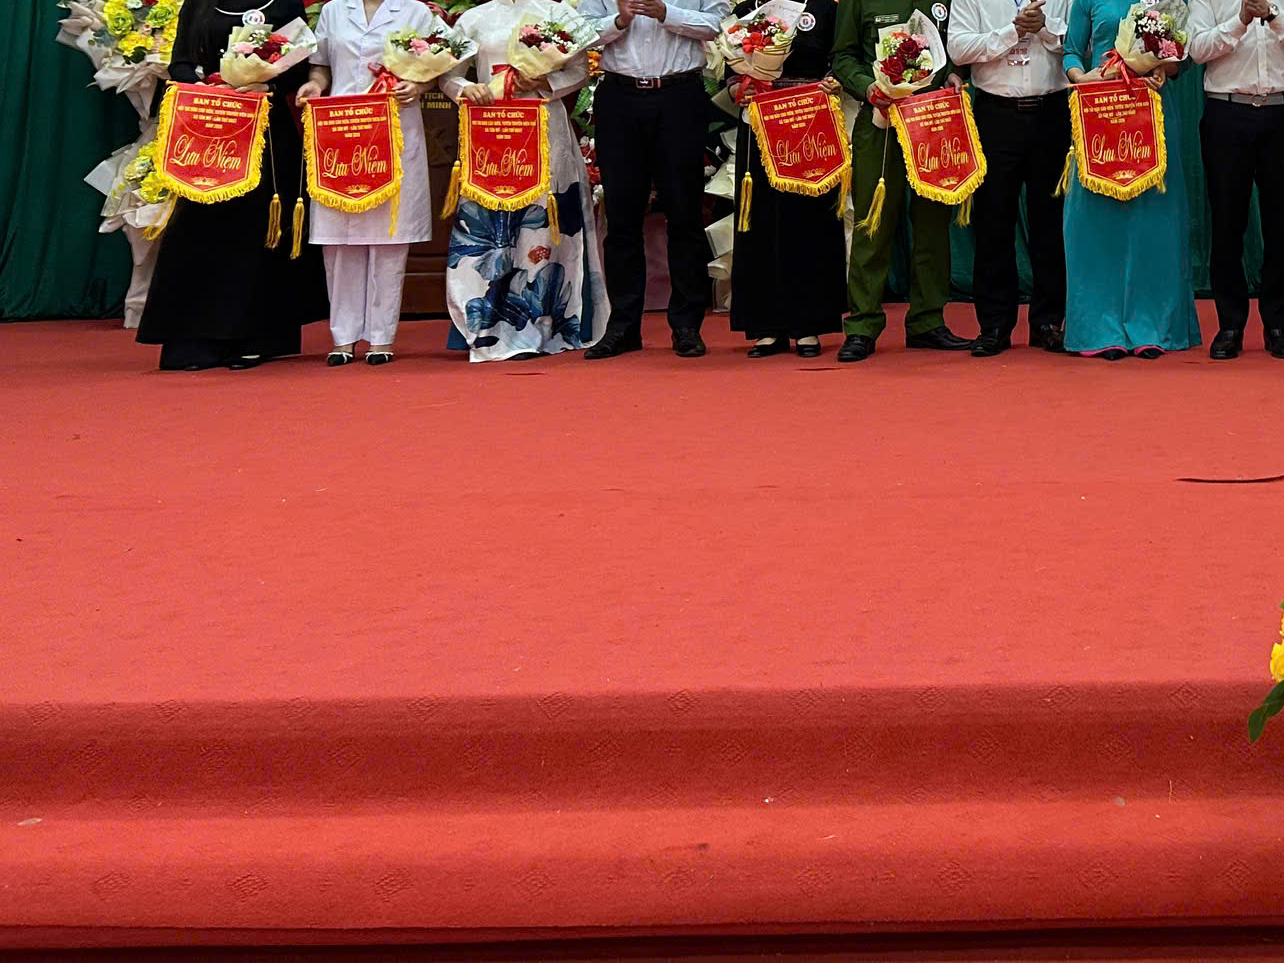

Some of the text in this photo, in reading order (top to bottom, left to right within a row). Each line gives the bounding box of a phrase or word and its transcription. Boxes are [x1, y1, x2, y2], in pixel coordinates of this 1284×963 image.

[169, 134, 241, 173] Lưu Niệm
[322, 145, 387, 178] Lưu Niệm
[475, 147, 534, 180] Lưu Niệm
[776, 132, 836, 166] Lưu Niệm
[918, 137, 968, 172] Lưu Niệm
[1091, 131, 1150, 164] Lưu Niệm
